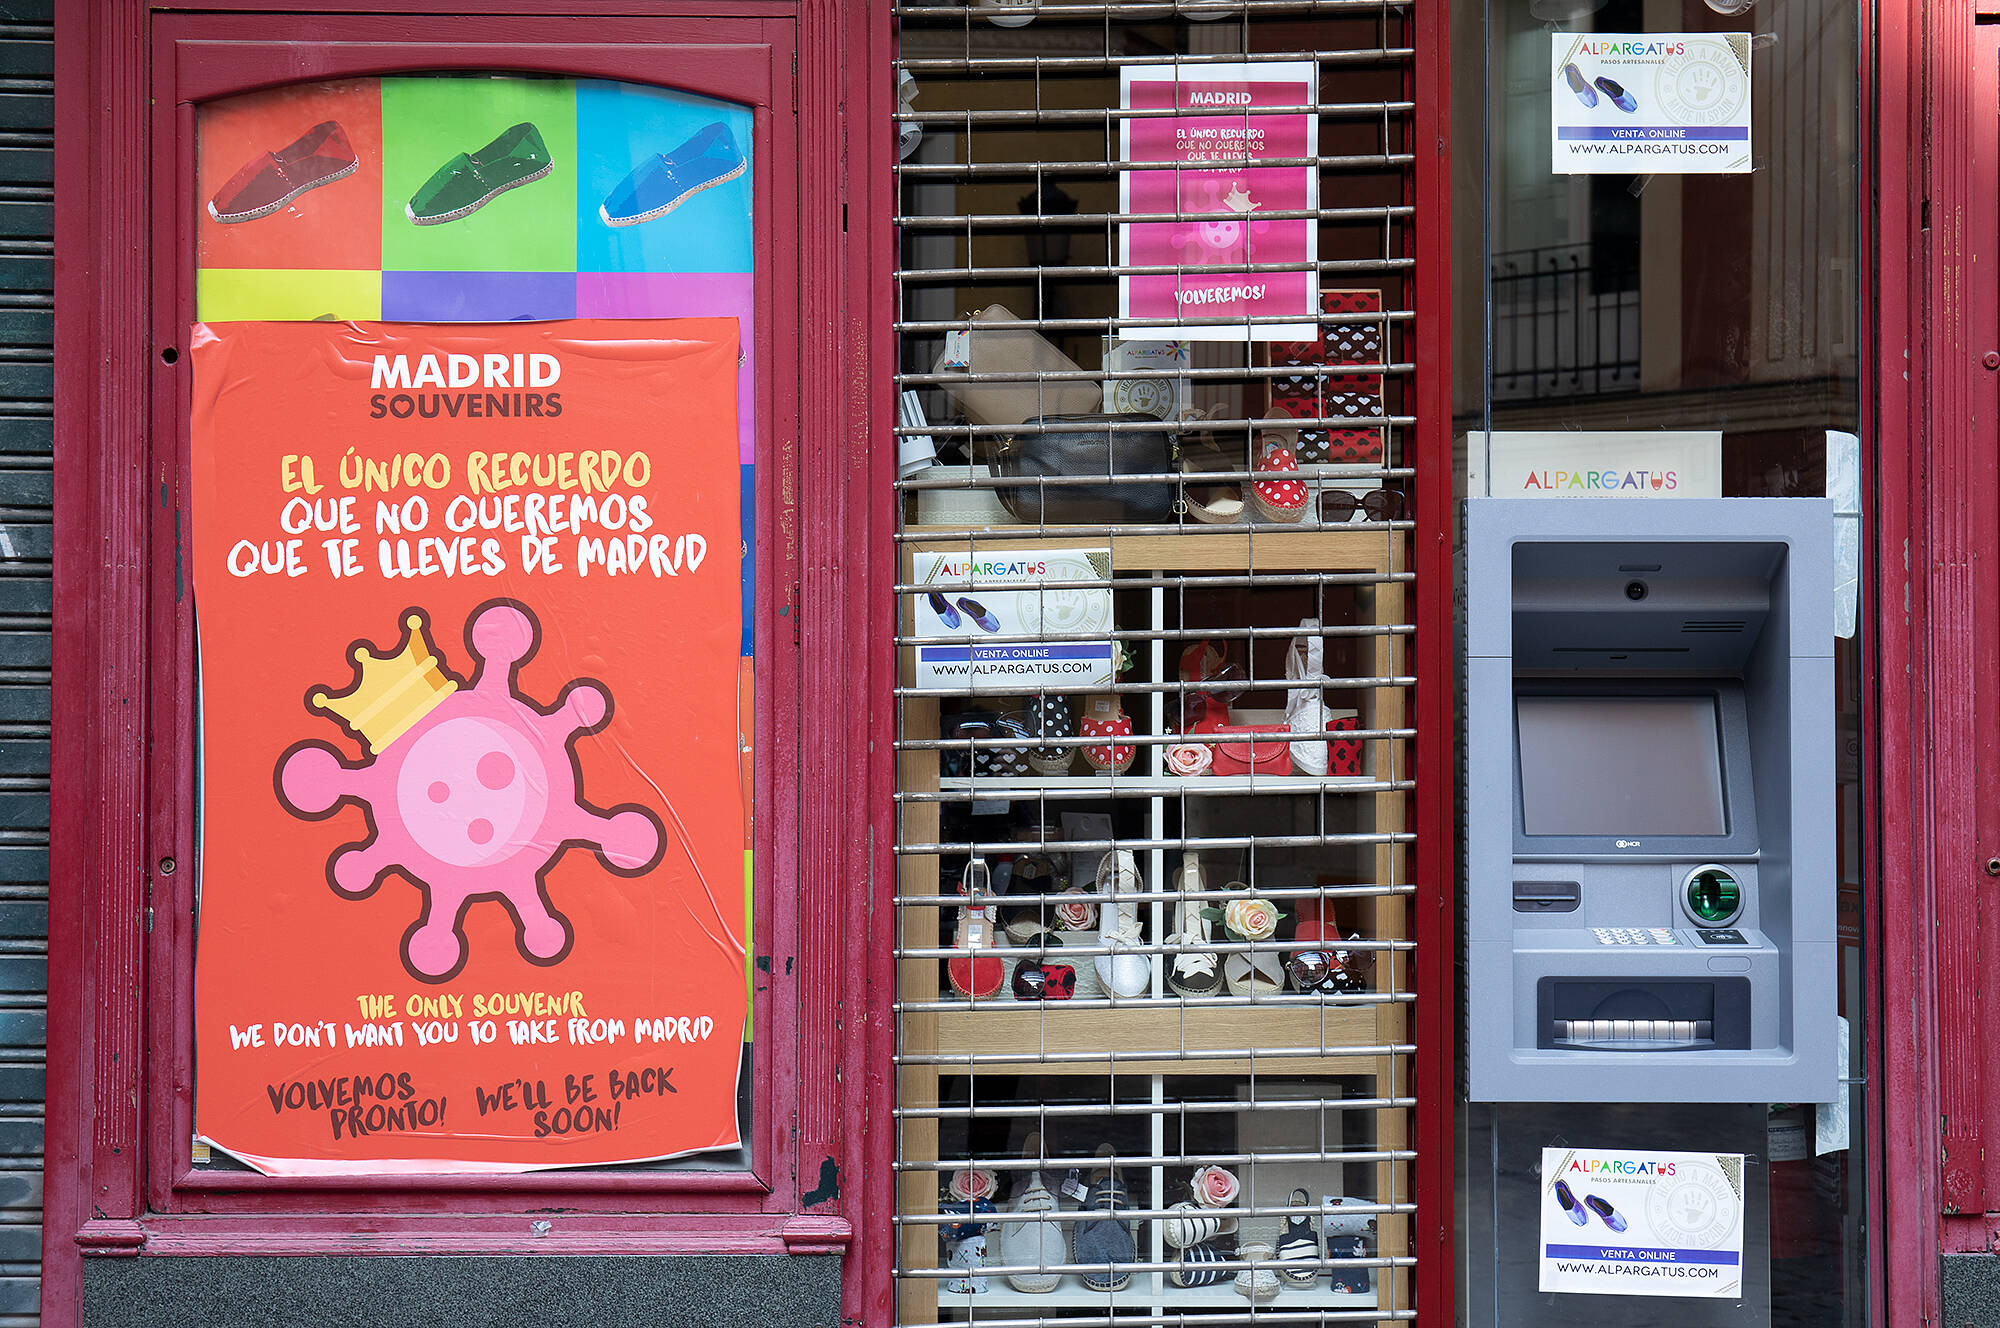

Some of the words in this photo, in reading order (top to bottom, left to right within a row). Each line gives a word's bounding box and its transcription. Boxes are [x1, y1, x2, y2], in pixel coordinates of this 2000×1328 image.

[1579, 42, 1685, 56] ALPARGATUS
[1190, 92, 1252, 105] MADRID
[1667, 98, 1694, 121] MADE
[1695, 112, 1706, 123] IN
[1708, 98, 1735, 121] SPAIN
[1176, 128, 1187, 139] EL
[1190, 126, 1218, 139] ÚNICO
[1220, 128, 1265, 140] RECUERDO
[1611, 129, 1646, 138] VENTA
[1648, 129, 1687, 138] ONLINE
[1176, 140, 1196, 150] QUE
[1198, 140, 1212, 150] NO
[1569, 144, 1729, 154] WWW.ALPARGATUS.COM
[1187, 151, 1207, 161] QUE
[1210, 151, 1220, 161] TE
[1174, 284, 1266, 305] VOLVEREMOS!
[370, 353, 562, 389] MADRID
[370, 393, 563, 419] SOUVENIRS
[281, 455, 325, 495] EL
[339, 445, 451, 493] ÚNICO
[467, 450, 651, 495] RECUERDO
[1523, 470, 1678, 491] ALPARGATUS
[280, 496, 361, 535] QUE
[375, 495, 429, 535] NO
[444, 493, 654, 536] QUEREMOS
[226, 539, 308, 578] QUE
[321, 538, 364, 580] TE
[378, 536, 507, 579] LLEVES
[521, 535, 563, 576] DE
[577, 533, 707, 578] MADRID
[940, 561, 1046, 576] ALPARGATUS
[974, 649, 1009, 659] VENTA
[1012, 648, 1049, 658] ONLINE
[932, 662, 1092, 675] WWWALPARGATUS.COM
[356, 993, 397, 1021] THE
[405, 993, 464, 1019] ONLY
[472, 990, 587, 1018] SOUVENIR
[229, 1021, 266, 1051] WE
[273, 1020, 337, 1048] DON'T
[344, 1021, 404, 1049] WANT
[411, 1020, 459, 1047] YOU
[467, 1020, 497, 1046] TO
[505, 1019, 560, 1046] TAKE
[567, 1017, 626, 1046] FROM
[634, 1015, 714, 1044] MADRID
[266, 1071, 416, 1115] VOLVEMOS
[475, 1077, 553, 1117] WE'LL
[564, 1073, 598, 1105] BE
[608, 1067, 678, 1101] BACK
[330, 1096, 447, 1141] PRONTO!
[533, 1100, 621, 1138] SOON!
[1569, 1159, 1676, 1176] ALPARGATUS
[1600, 1249, 1636, 1259] VENTA
[1638, 1250, 1676, 1260] ONLINE
[1557, 1263, 1719, 1278] WWW.ALPARGATUS.COM
